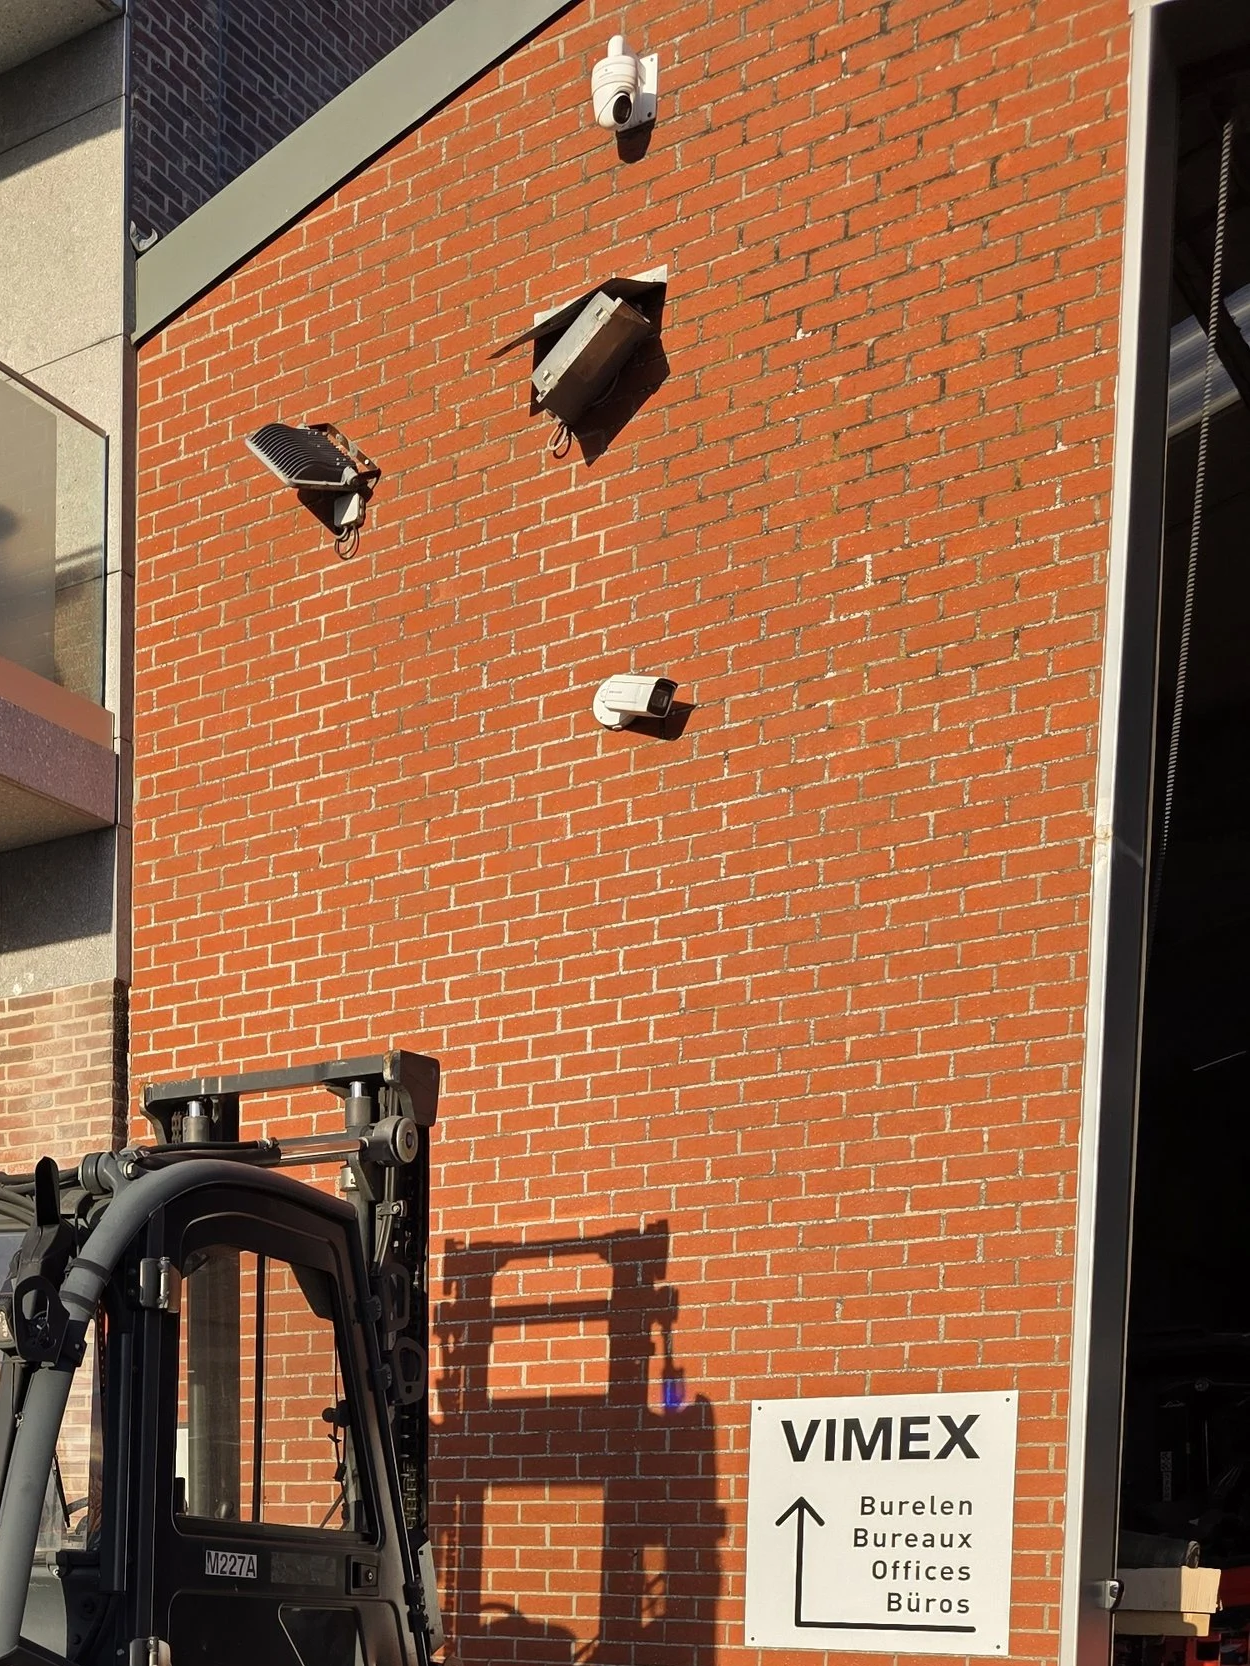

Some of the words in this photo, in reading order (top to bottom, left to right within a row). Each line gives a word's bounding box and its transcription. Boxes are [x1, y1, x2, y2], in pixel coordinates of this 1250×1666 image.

[780, 1414, 981, 1463] VIMEX
[860, 1495, 973, 1516] Burelen
[853, 1527, 972, 1549] Bureaux
[206, 1551, 256, 1577] M227A
[872, 1559, 971, 1581] Offices
[887, 1591, 970, 1614] Büros
